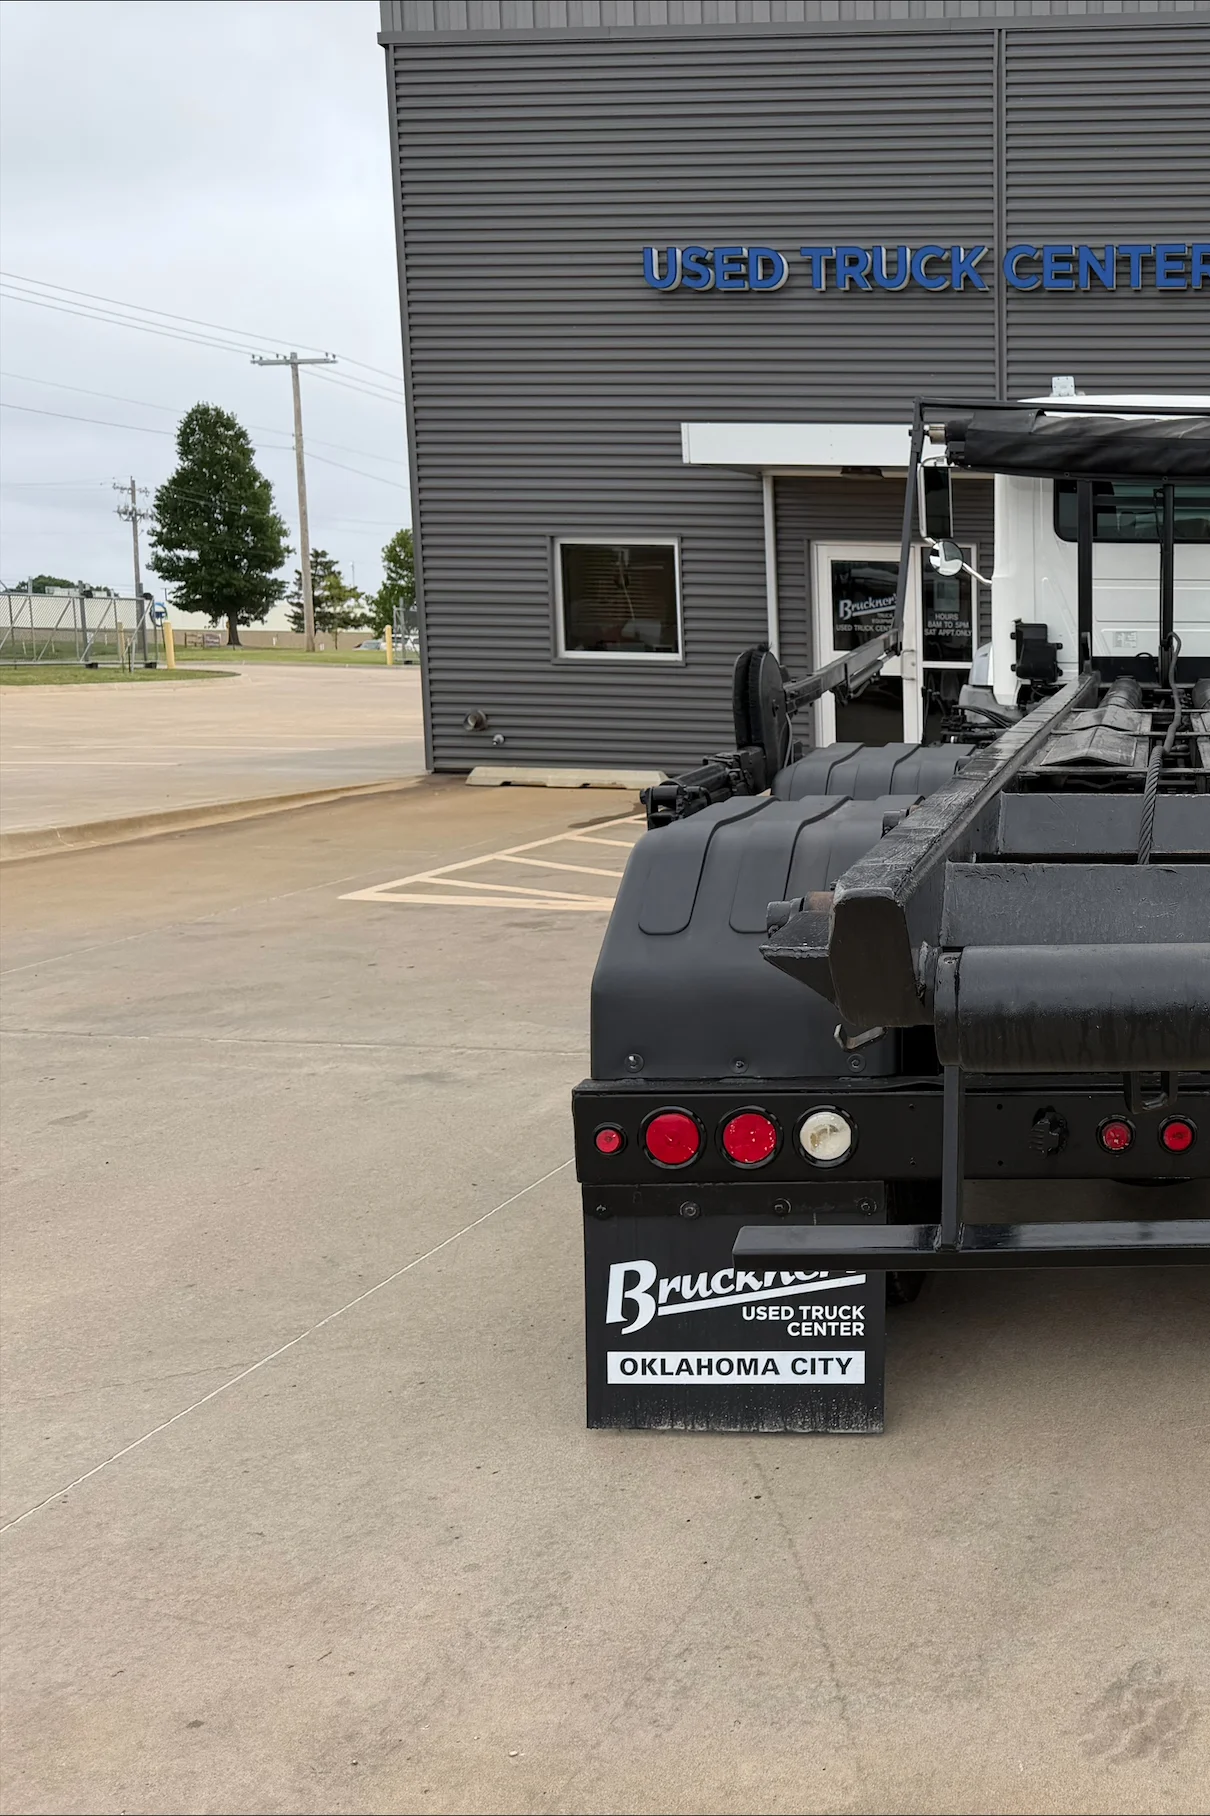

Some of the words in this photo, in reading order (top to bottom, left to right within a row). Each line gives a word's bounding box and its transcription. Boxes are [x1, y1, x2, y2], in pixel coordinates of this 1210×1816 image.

[642, 246, 788, 291] USED
[800, 244, 990, 291] TRUCK
[836, 624, 853, 632] USED
[854, 624, 874, 632] TRUCK
[875, 624, 892, 632] CENT
[606, 1259, 857, 1335] Bruckn
[742, 1305, 794, 1321] USED
[799, 1305, 866, 1320] TRUCK
[787, 1321, 865, 1337] CENTER
[619, 1357, 780, 1376] OKLAHOMA
[790, 1357, 854, 1376] CITY
